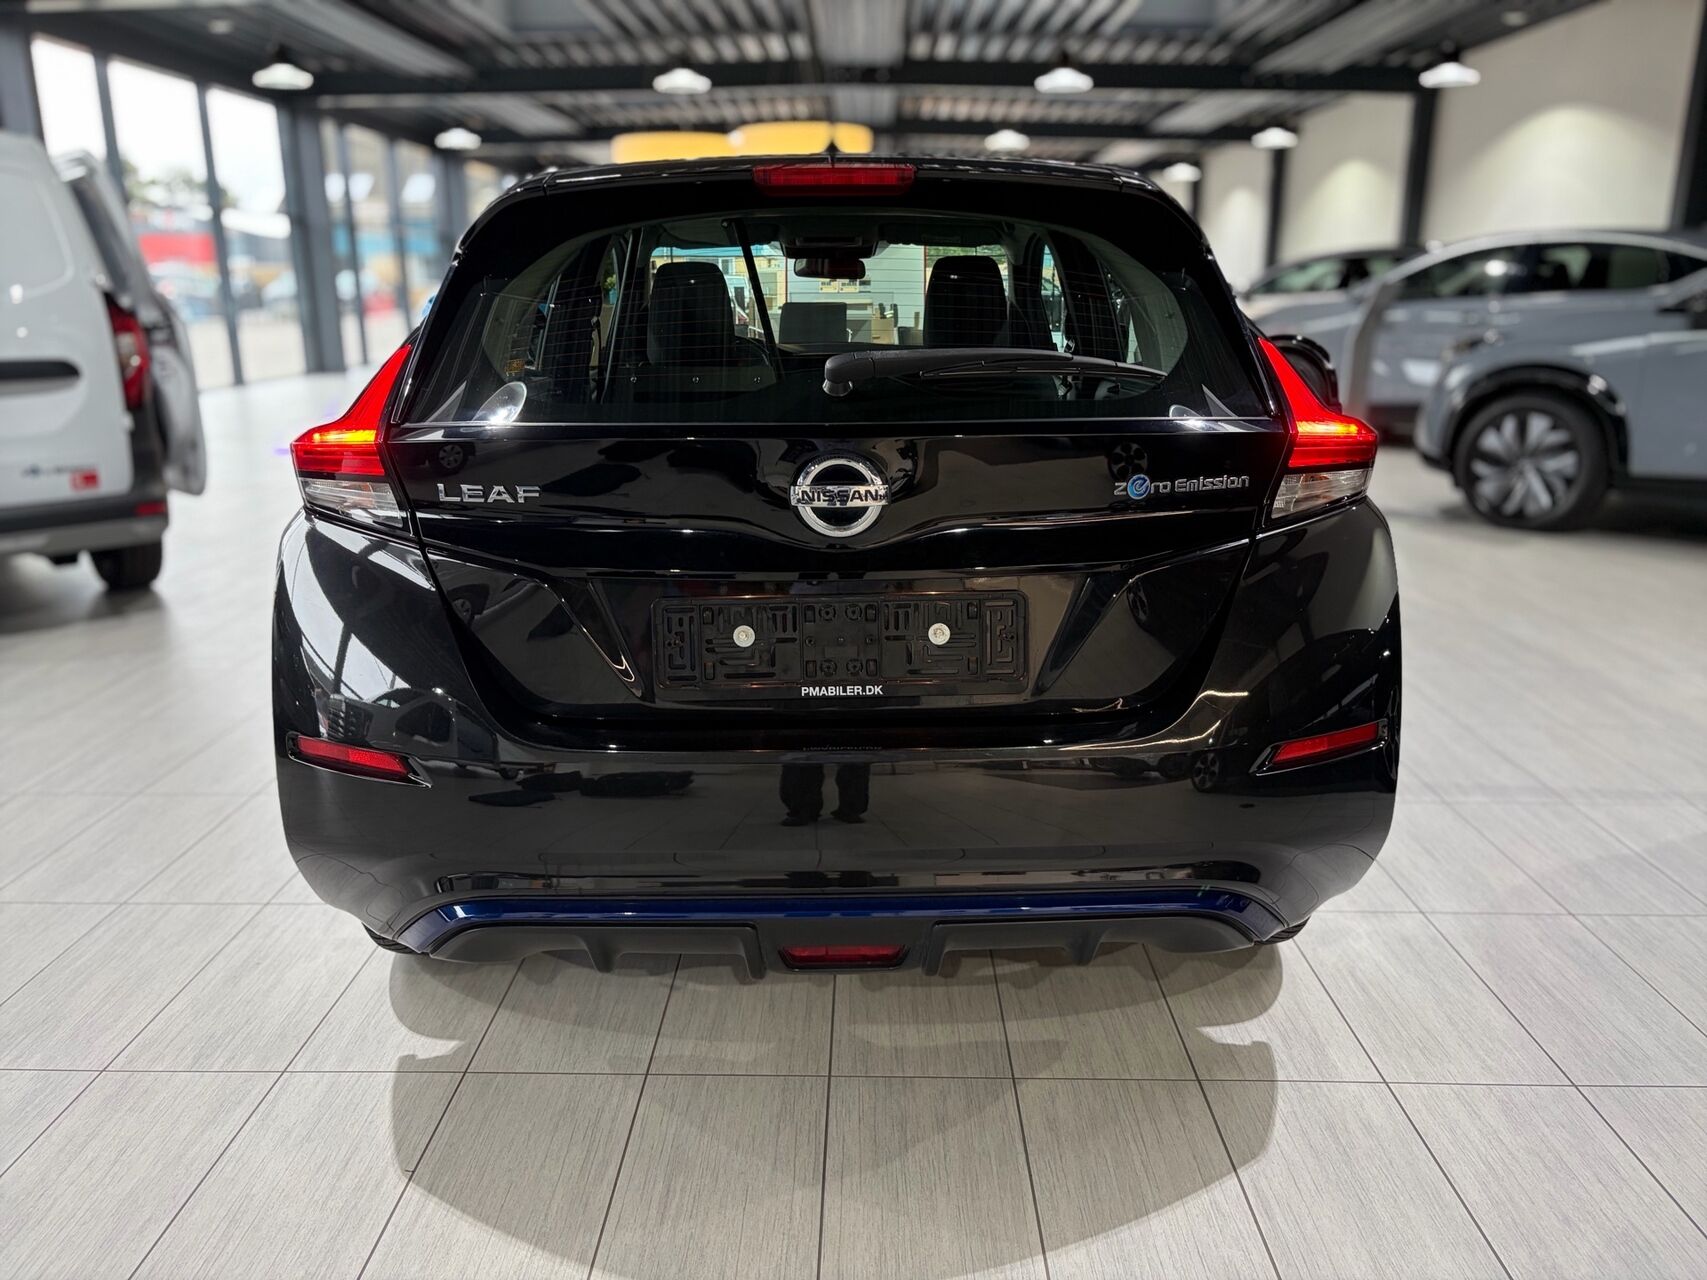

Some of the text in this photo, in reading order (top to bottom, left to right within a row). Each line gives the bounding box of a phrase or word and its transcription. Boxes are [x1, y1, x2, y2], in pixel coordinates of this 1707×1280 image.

[1174, 475, 1250, 492] Emission
[436, 483, 541, 503] LEAF
[800, 488, 880, 503] NISSAN
[801, 685, 884, 697] PMABILER.DK
